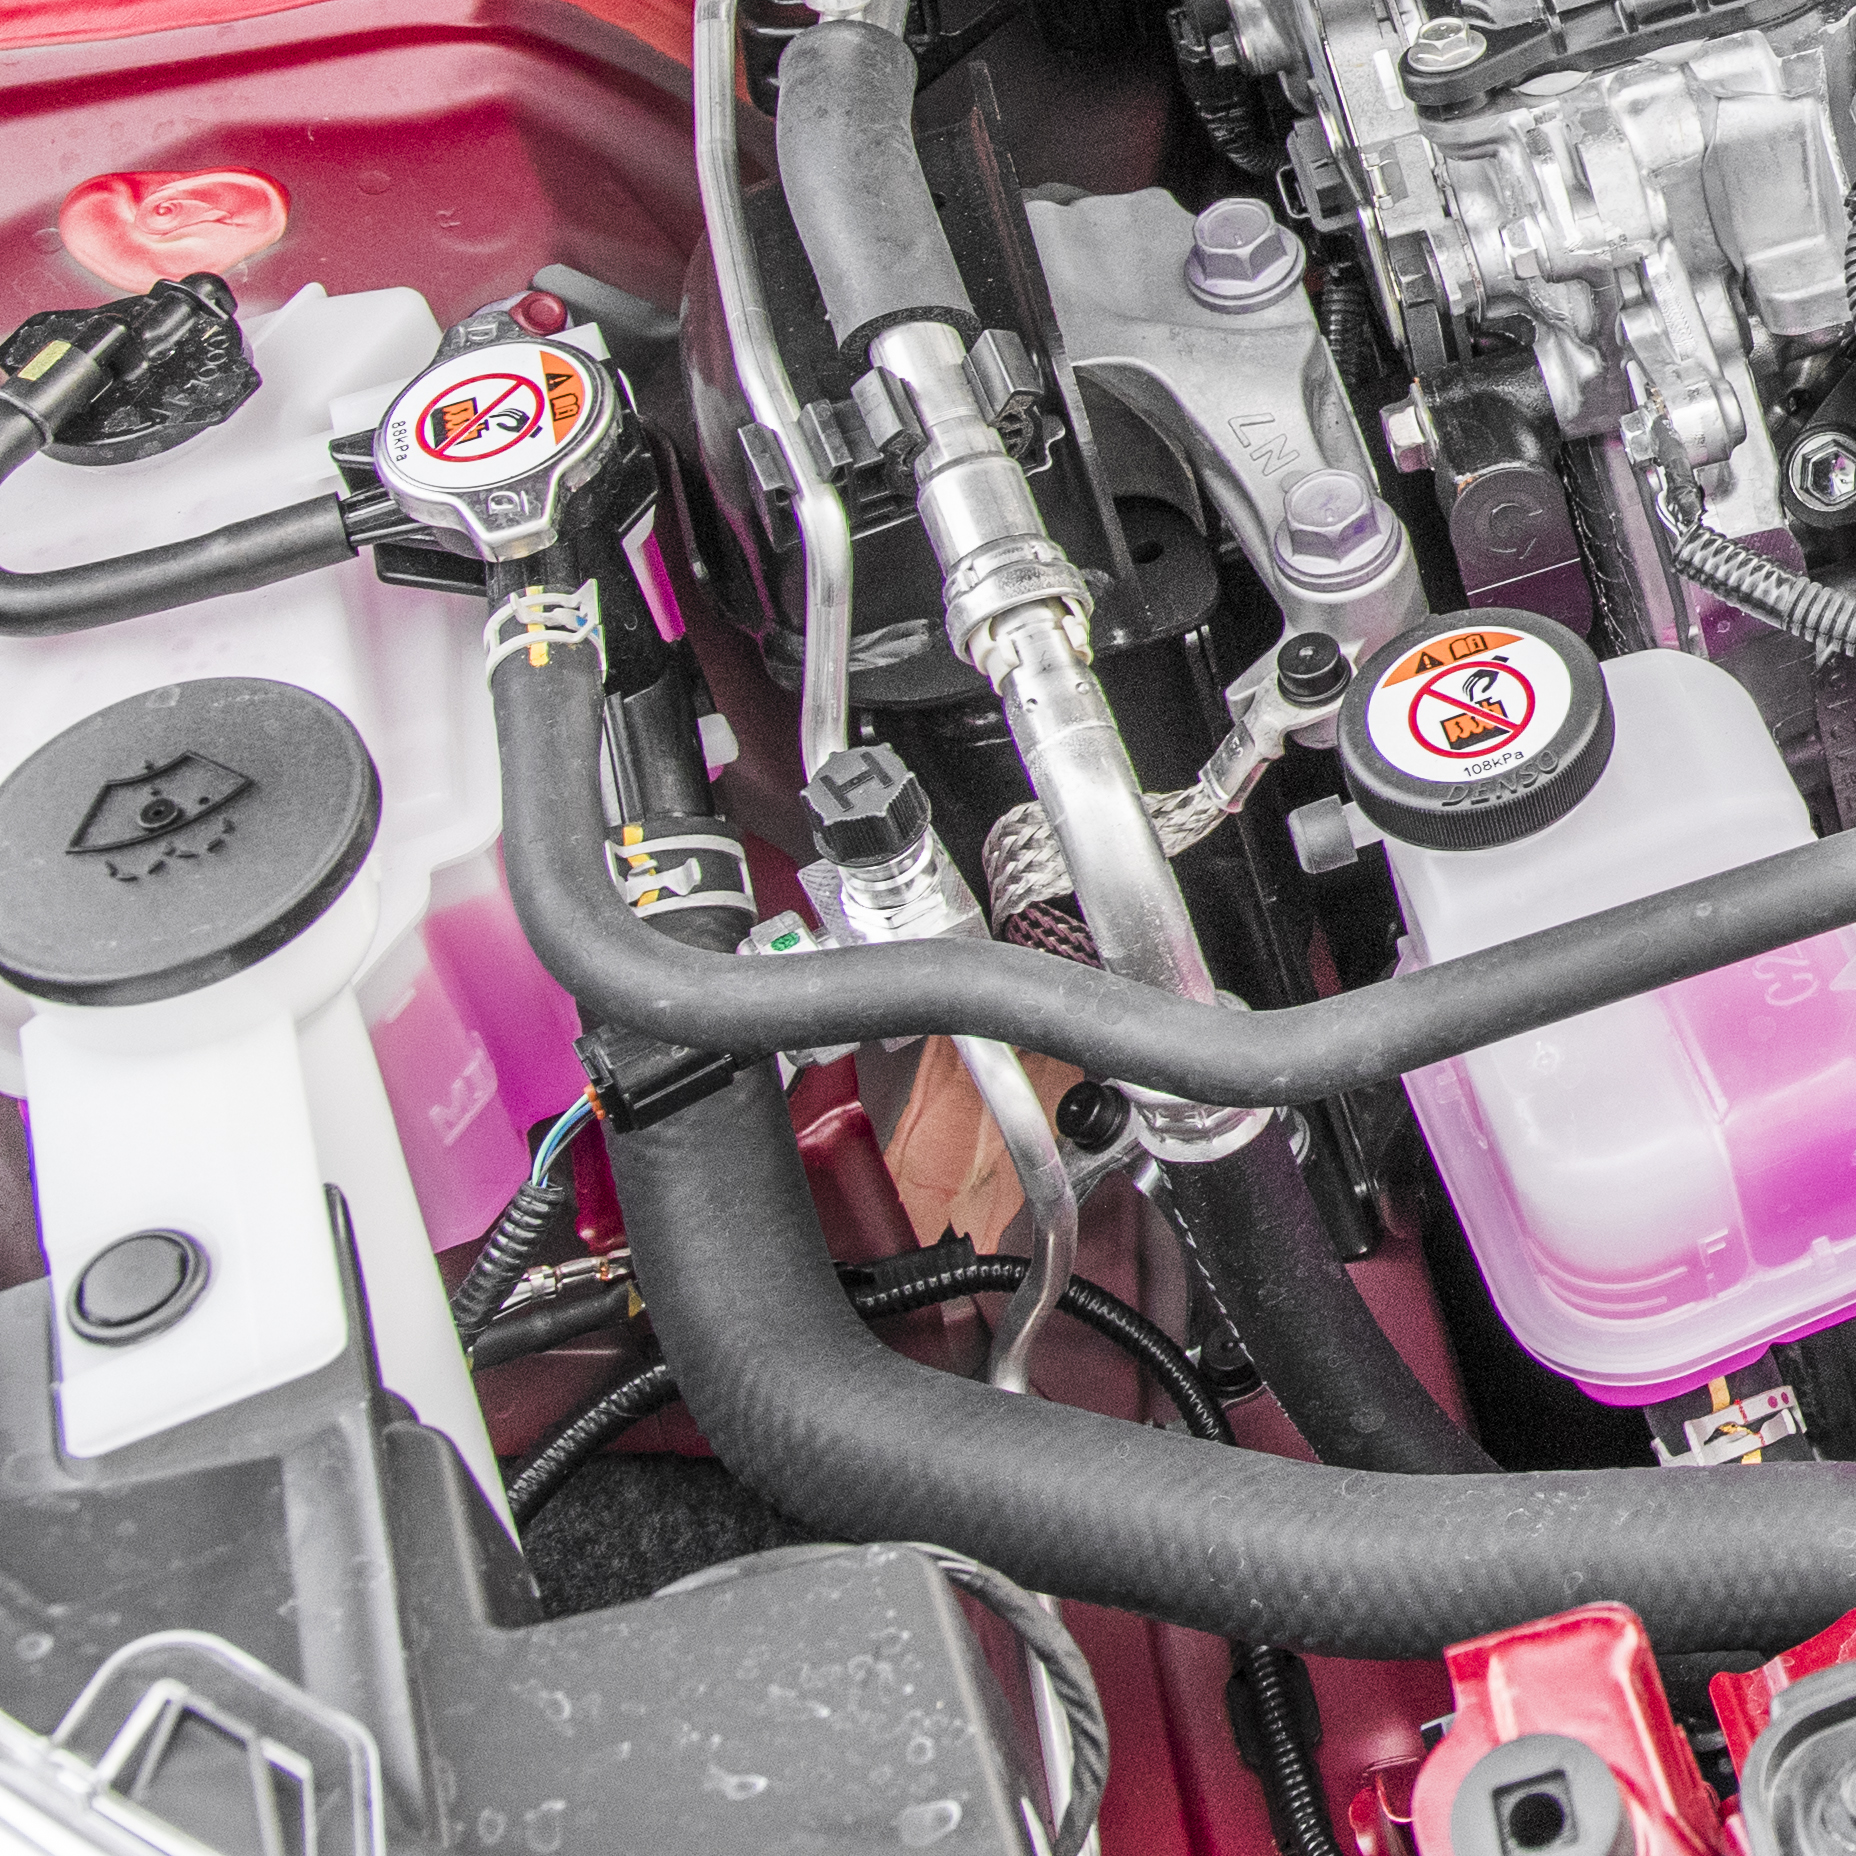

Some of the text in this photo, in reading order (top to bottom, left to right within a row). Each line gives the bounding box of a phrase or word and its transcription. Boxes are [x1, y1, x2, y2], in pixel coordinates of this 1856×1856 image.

[391, 420, 408, 462] 88kPa
[819, 751, 895, 813] H
[1442, 750, 1559, 806] DENSO
[1463, 750, 1525, 777] 108kPa
